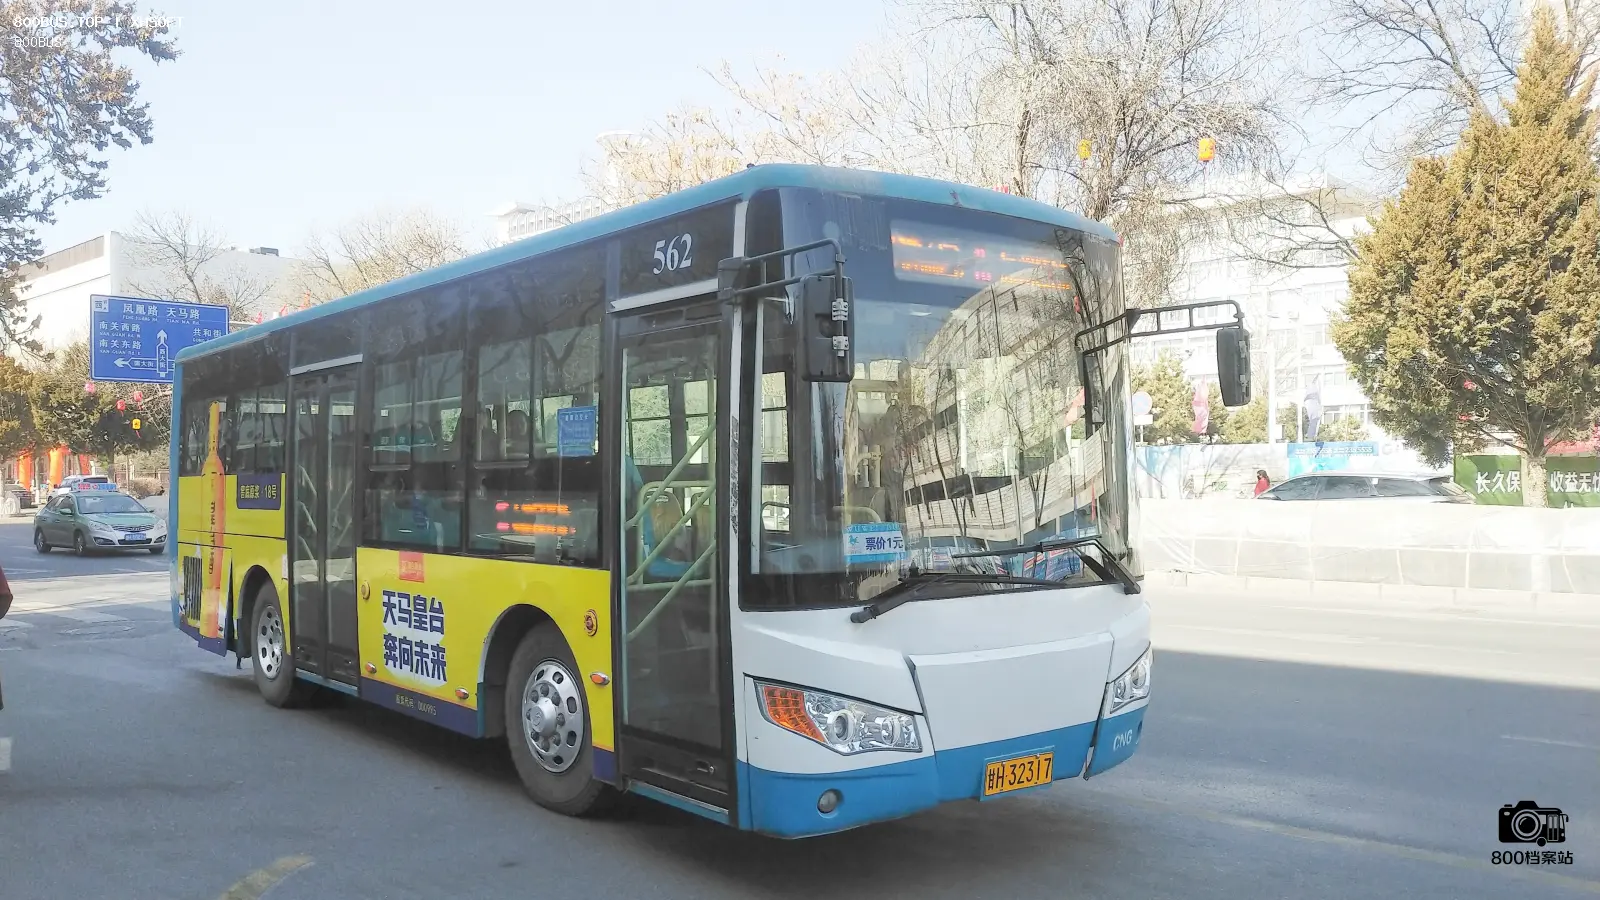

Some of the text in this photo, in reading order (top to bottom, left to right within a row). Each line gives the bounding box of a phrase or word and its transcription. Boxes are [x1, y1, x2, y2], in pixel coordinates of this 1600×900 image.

[652, 233, 692, 275] 562
[122, 303, 158, 317] 凤凰路
[166, 307, 200, 320] 天马路
[99, 320, 141, 333] 南关西路
[192, 327, 222, 338] 共和街
[99, 338, 142, 350] 南关东路
[865, 536, 904, 551] 票价1元
[382, 589, 445, 635] 天马皇台
[383, 632, 448, 682] 奔向未来
[1113, 729, 1133, 751] CNG
